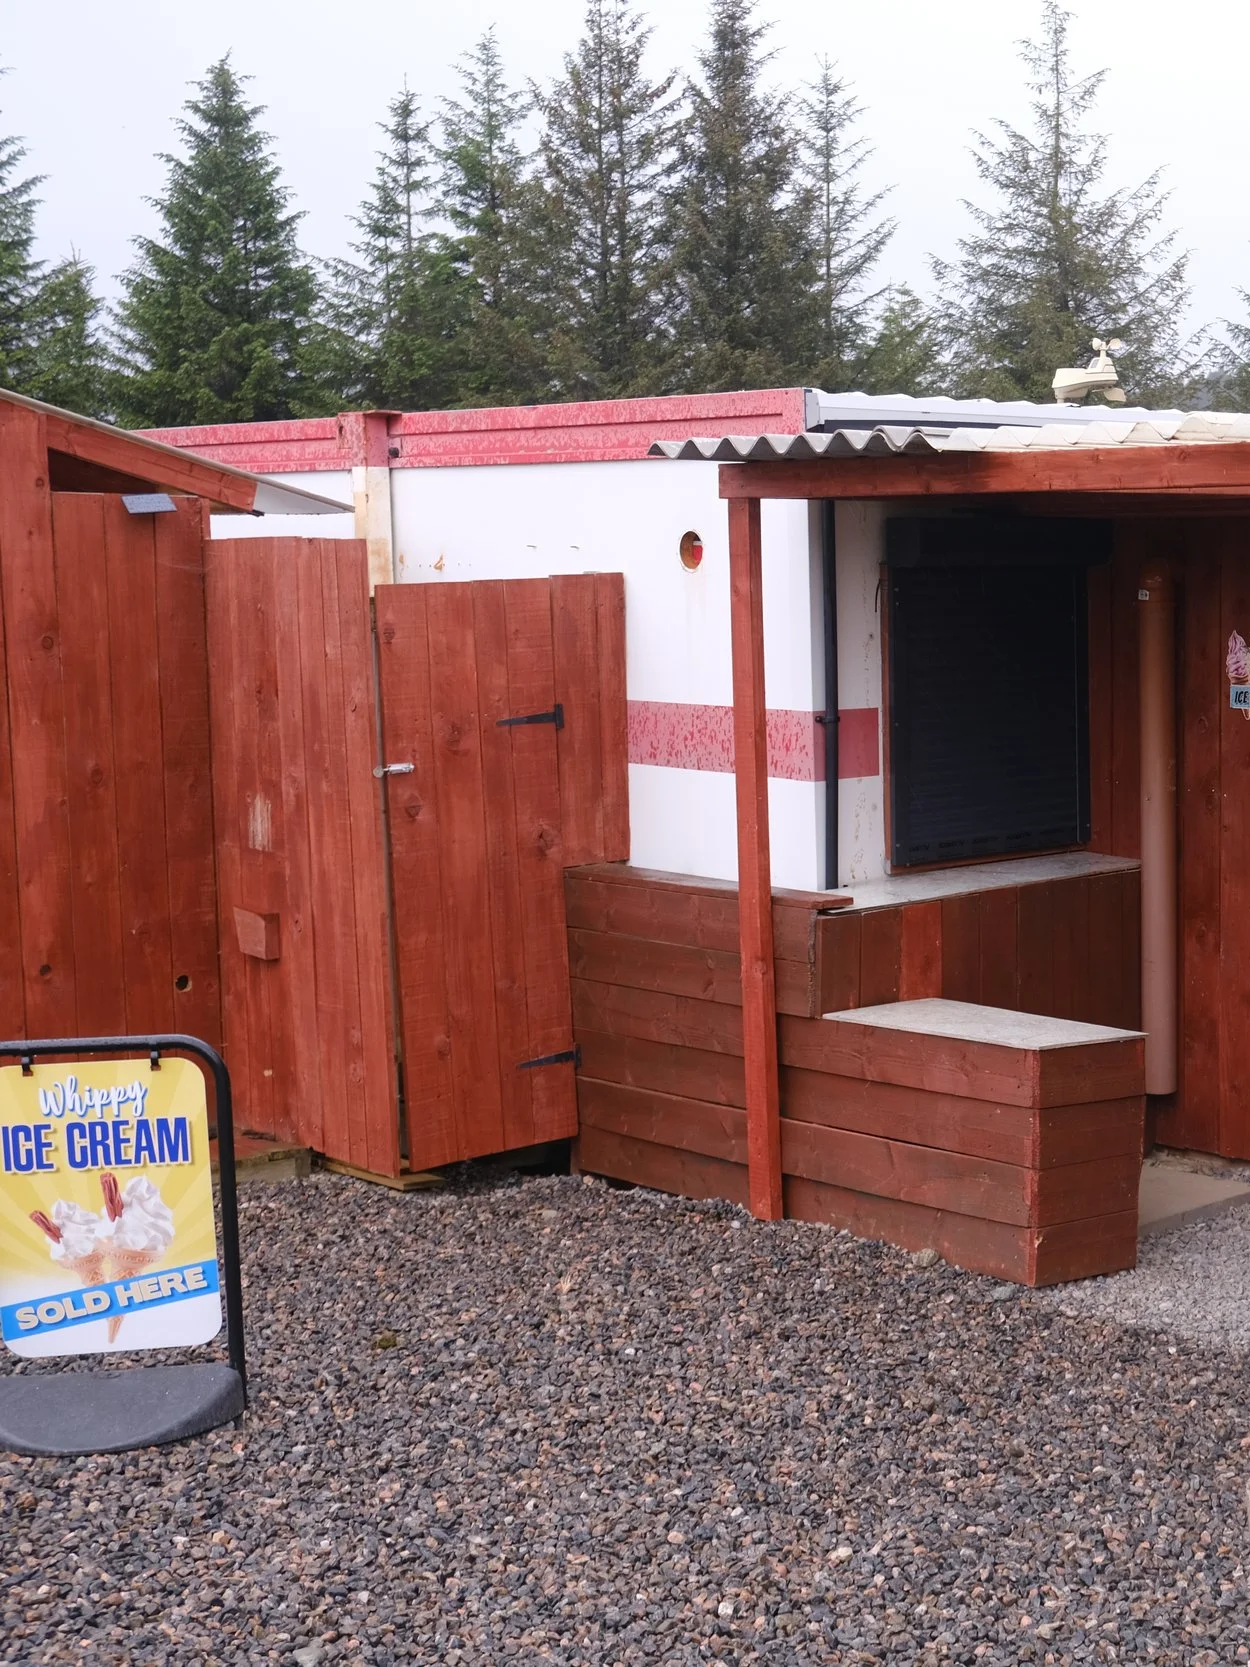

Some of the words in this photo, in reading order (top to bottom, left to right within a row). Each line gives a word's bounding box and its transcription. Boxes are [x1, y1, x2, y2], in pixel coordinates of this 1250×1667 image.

[1235, 691, 1249, 704] ICE
[38, 1074, 148, 1119] Whippy
[2, 1123, 54, 1172] ICE
[66, 1117, 190, 1169] CREAM
[15, 1291, 111, 1332] SOLD
[116, 1266, 207, 1308] HERE
